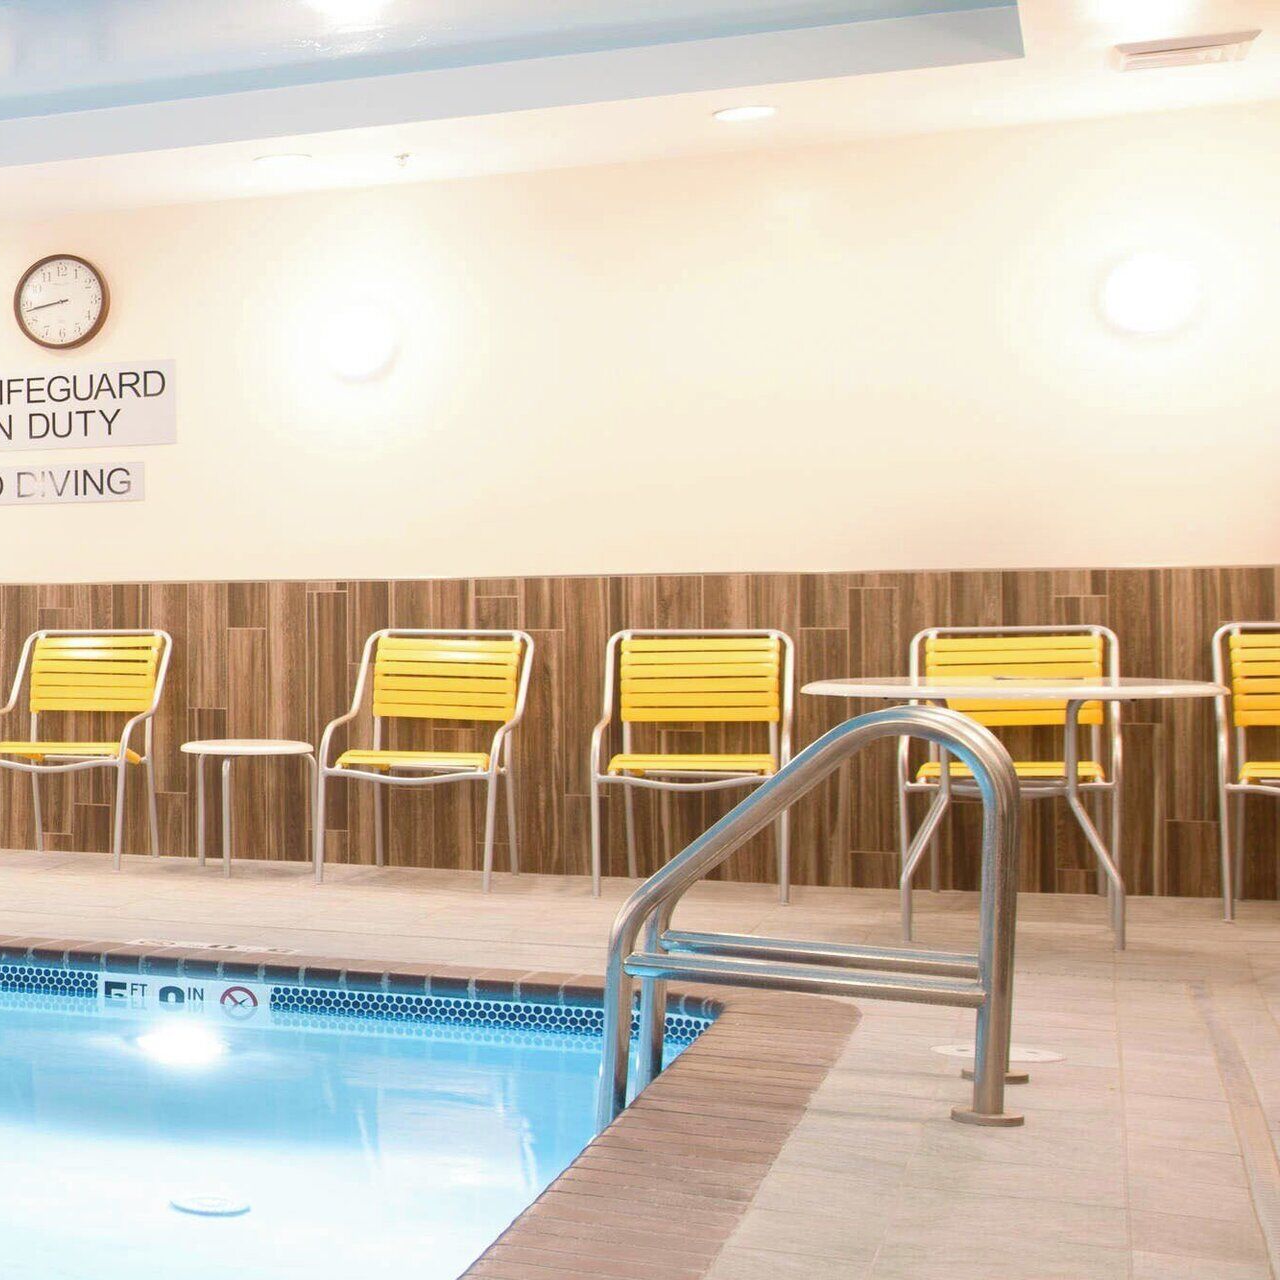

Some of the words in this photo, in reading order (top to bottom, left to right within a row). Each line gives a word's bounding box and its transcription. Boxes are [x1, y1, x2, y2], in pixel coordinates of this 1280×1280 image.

[28, 408, 121, 439] DUTY
[130, 982, 148, 998] FT
[187, 986, 205, 1002] IN
